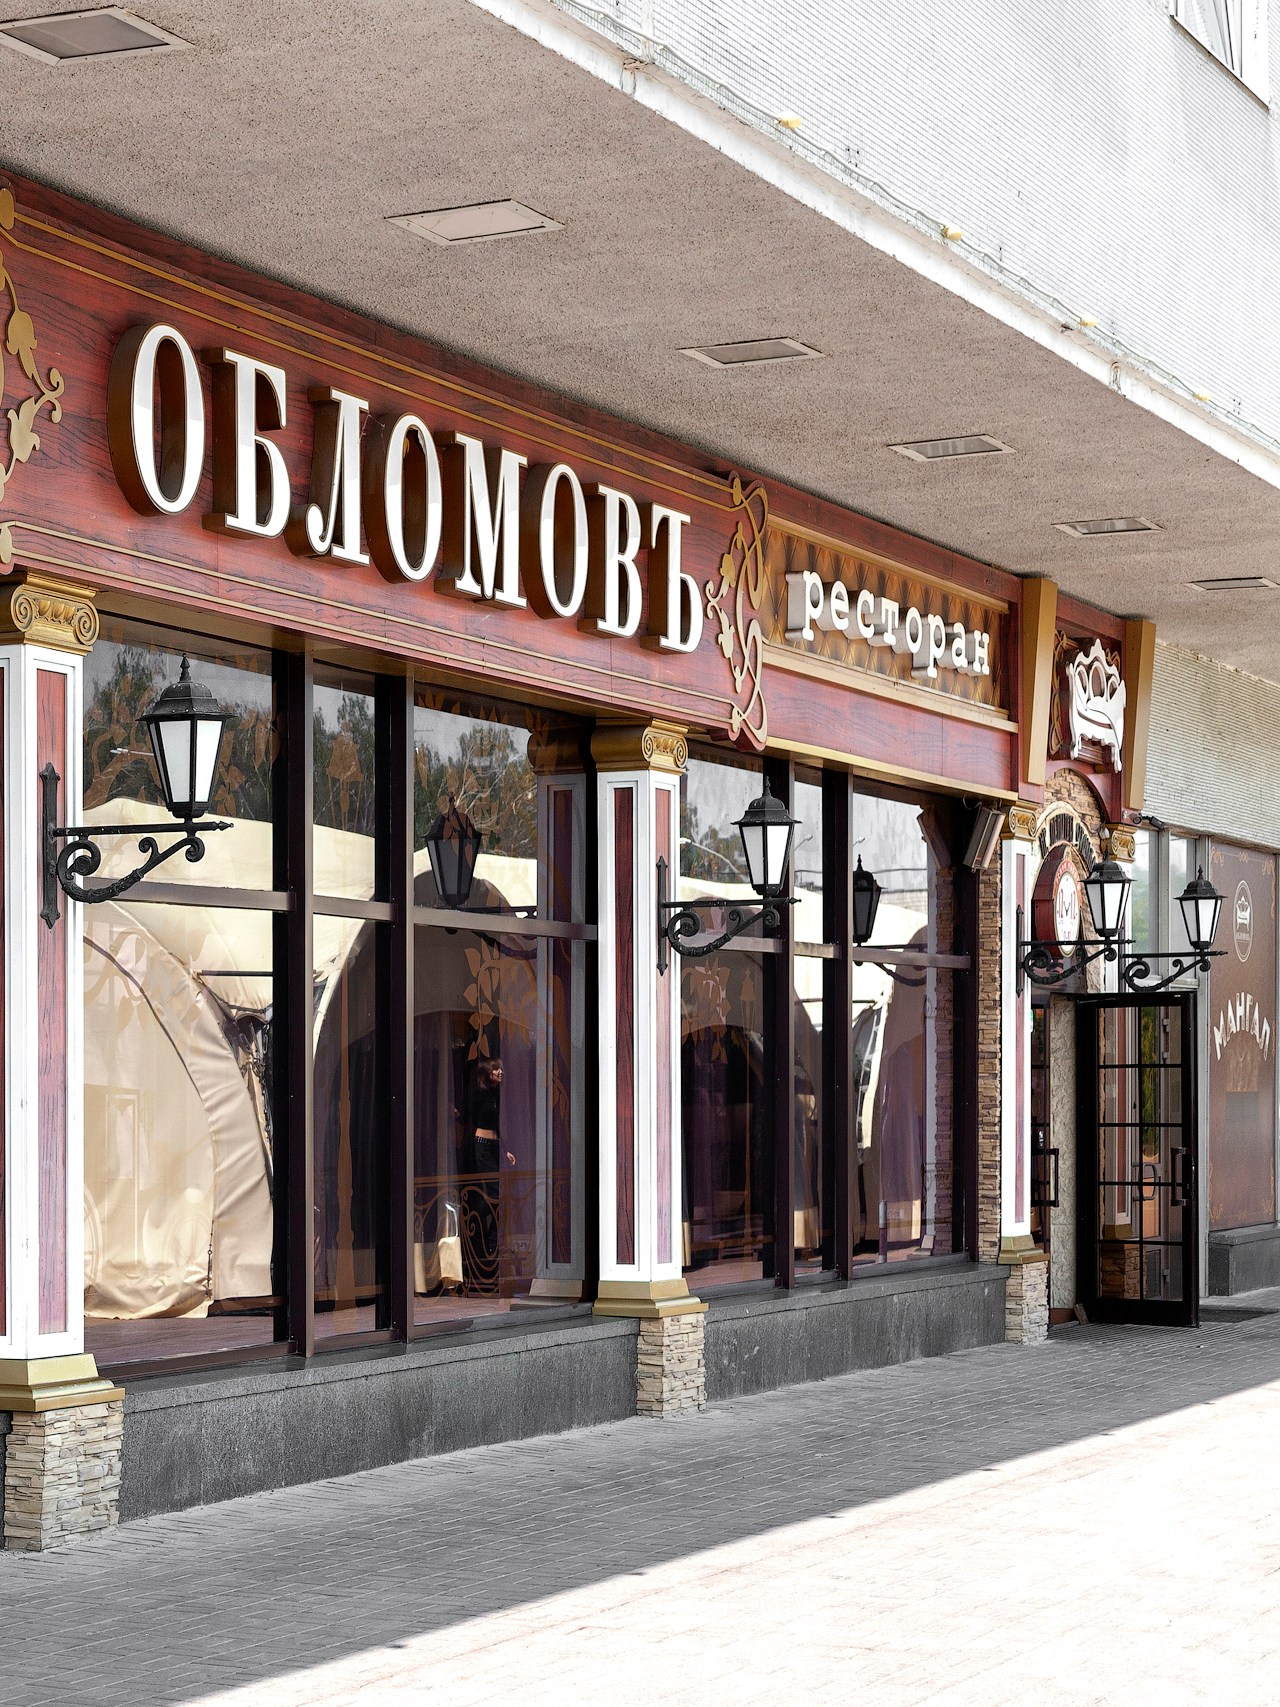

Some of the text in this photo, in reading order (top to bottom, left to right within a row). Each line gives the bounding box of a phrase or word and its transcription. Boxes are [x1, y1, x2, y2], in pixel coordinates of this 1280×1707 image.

[124, 322, 704, 655] ОБЛОМОВЪ
[796, 569, 990, 679] ресторан
[1213, 991, 1271, 1061] МАНГАЛ
